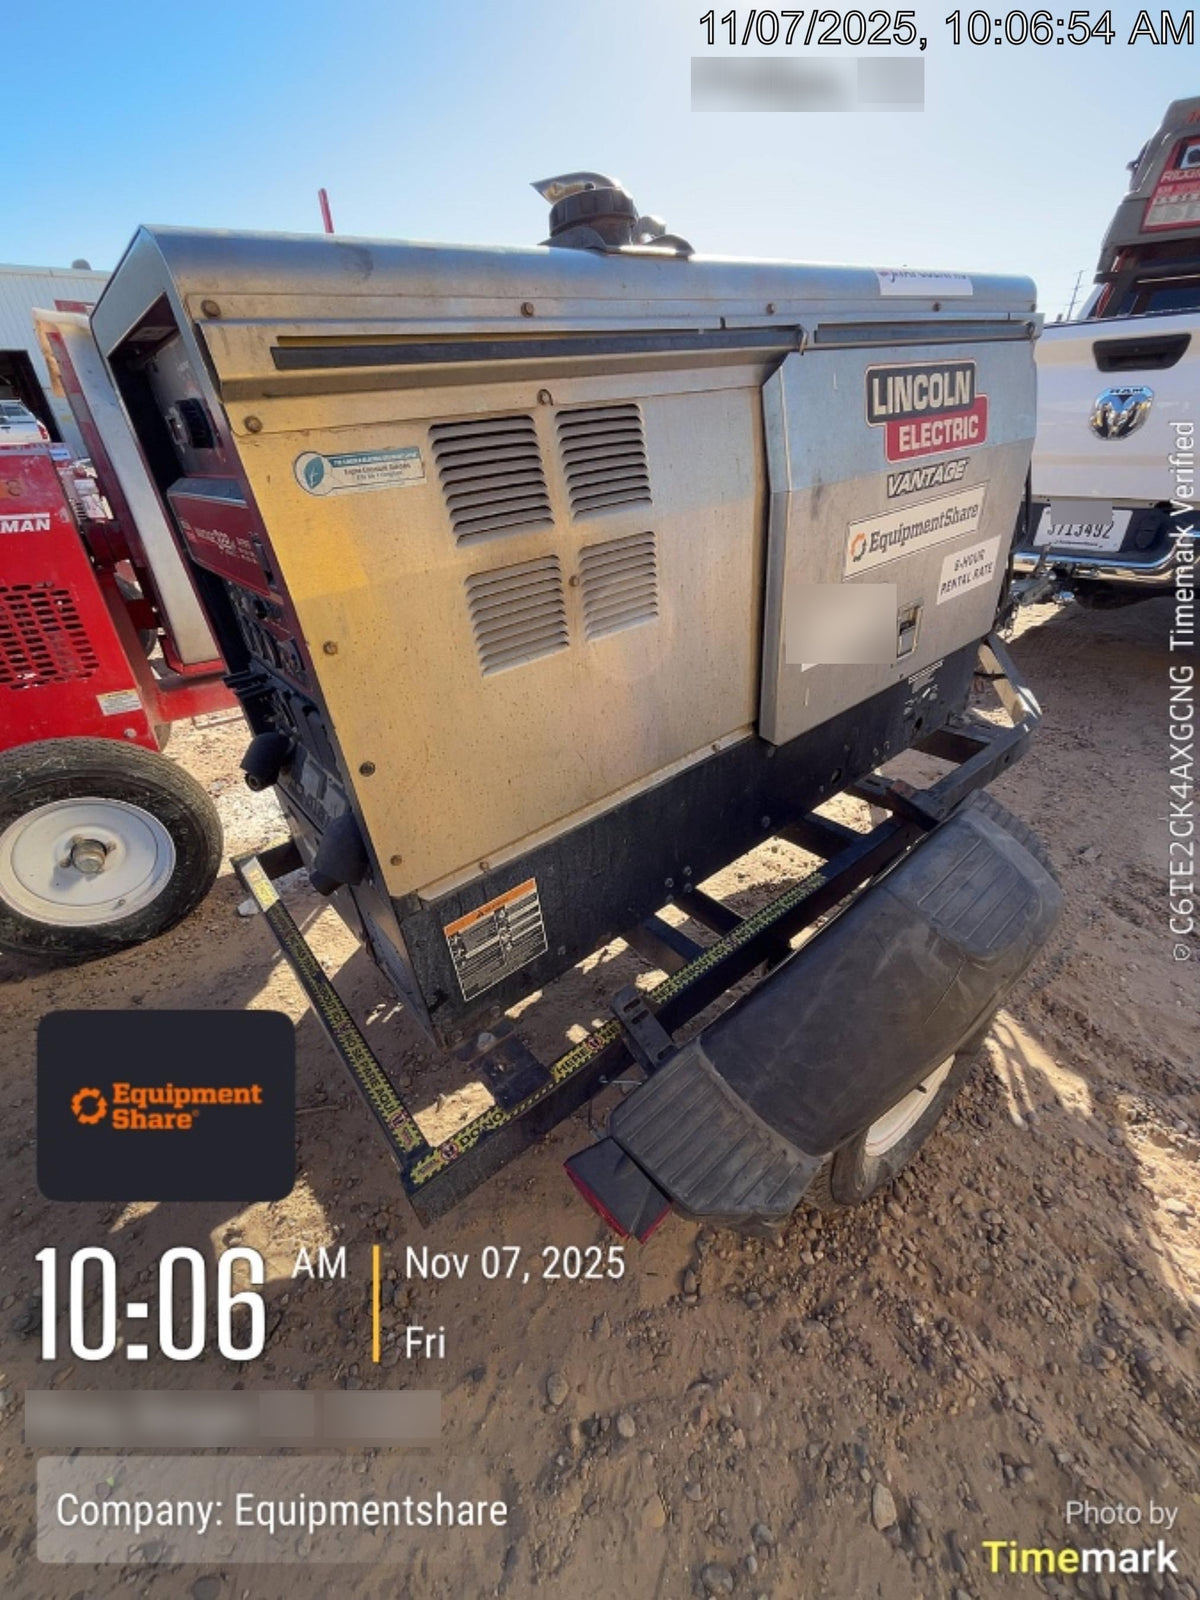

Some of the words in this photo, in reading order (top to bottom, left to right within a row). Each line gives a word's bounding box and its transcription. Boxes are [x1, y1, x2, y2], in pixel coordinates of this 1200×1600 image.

[873, 368, 972, 416] LINCOLN
[899, 414, 979, 452] ELECTRIC
[887, 457, 970, 498] VANTAGE
[869, 503, 979, 555] EquipmentShare
[940, 573, 971, 596] RENTAL
[973, 561, 993, 579] RATE
